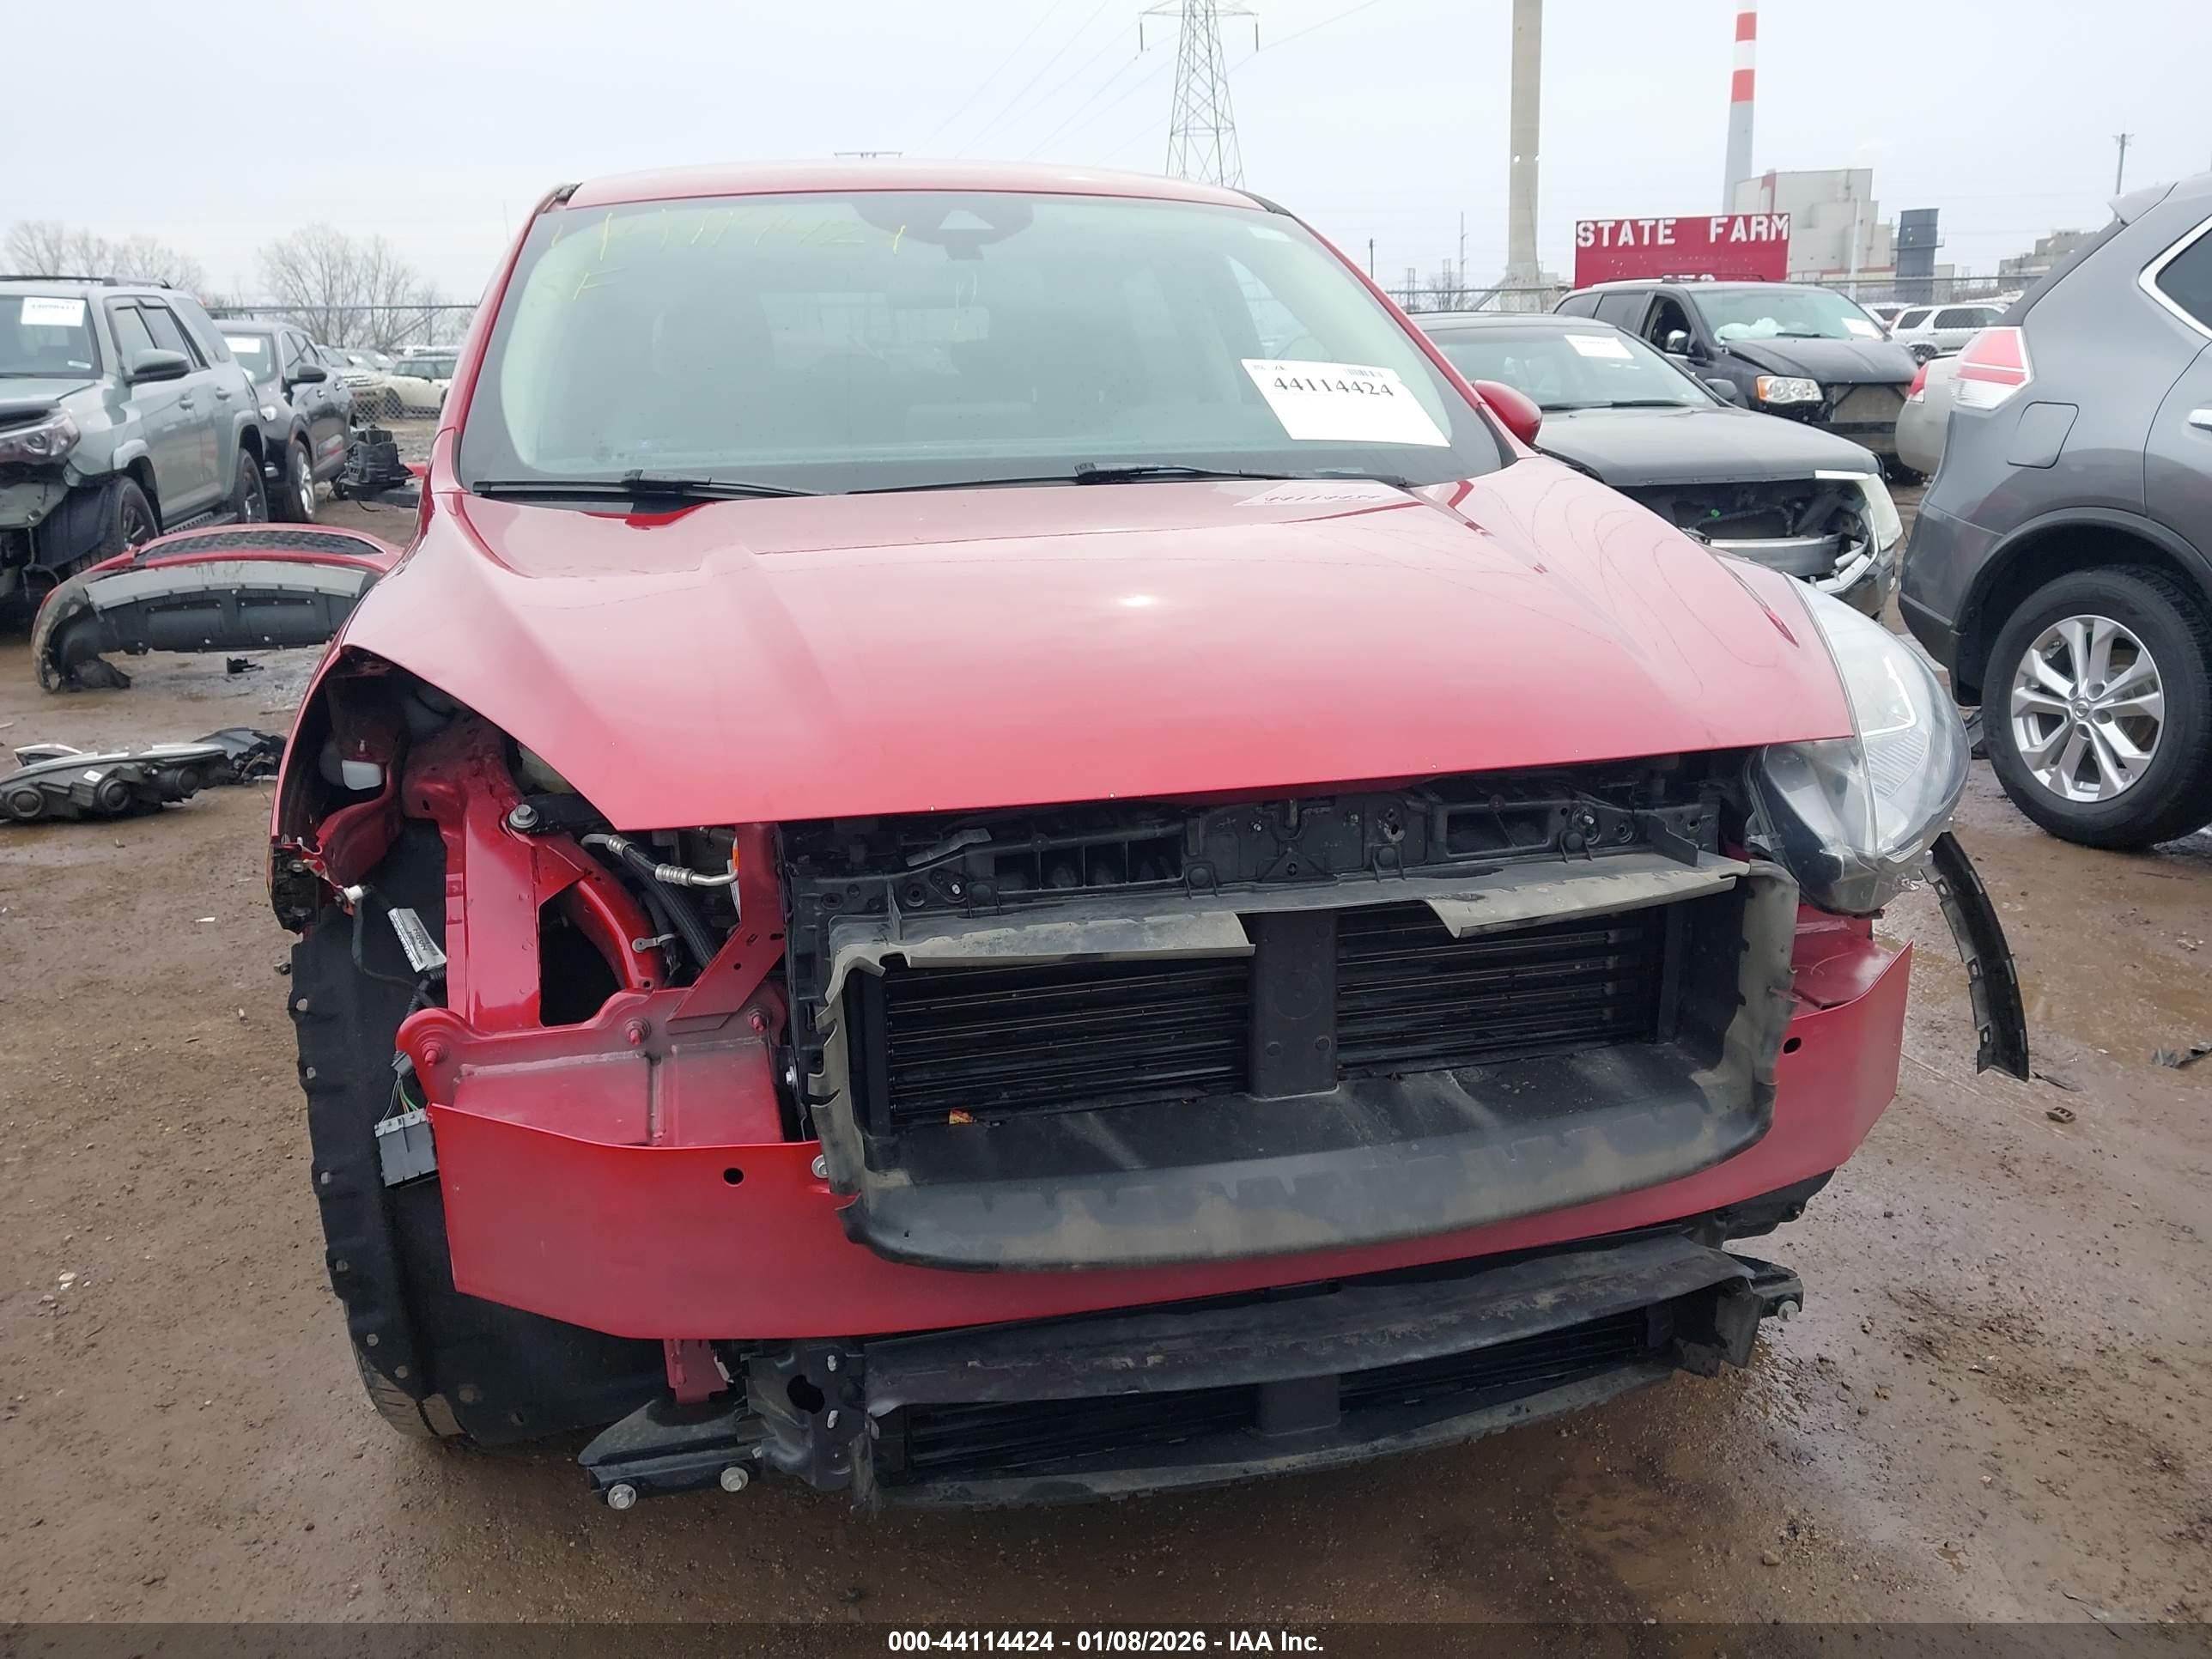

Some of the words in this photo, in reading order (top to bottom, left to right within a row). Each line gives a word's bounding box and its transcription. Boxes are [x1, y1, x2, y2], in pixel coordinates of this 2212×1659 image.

[1577, 219, 1677, 248] STATE
[1709, 214, 1790, 244] FARM
[1273, 377, 1395, 397] 44114424
